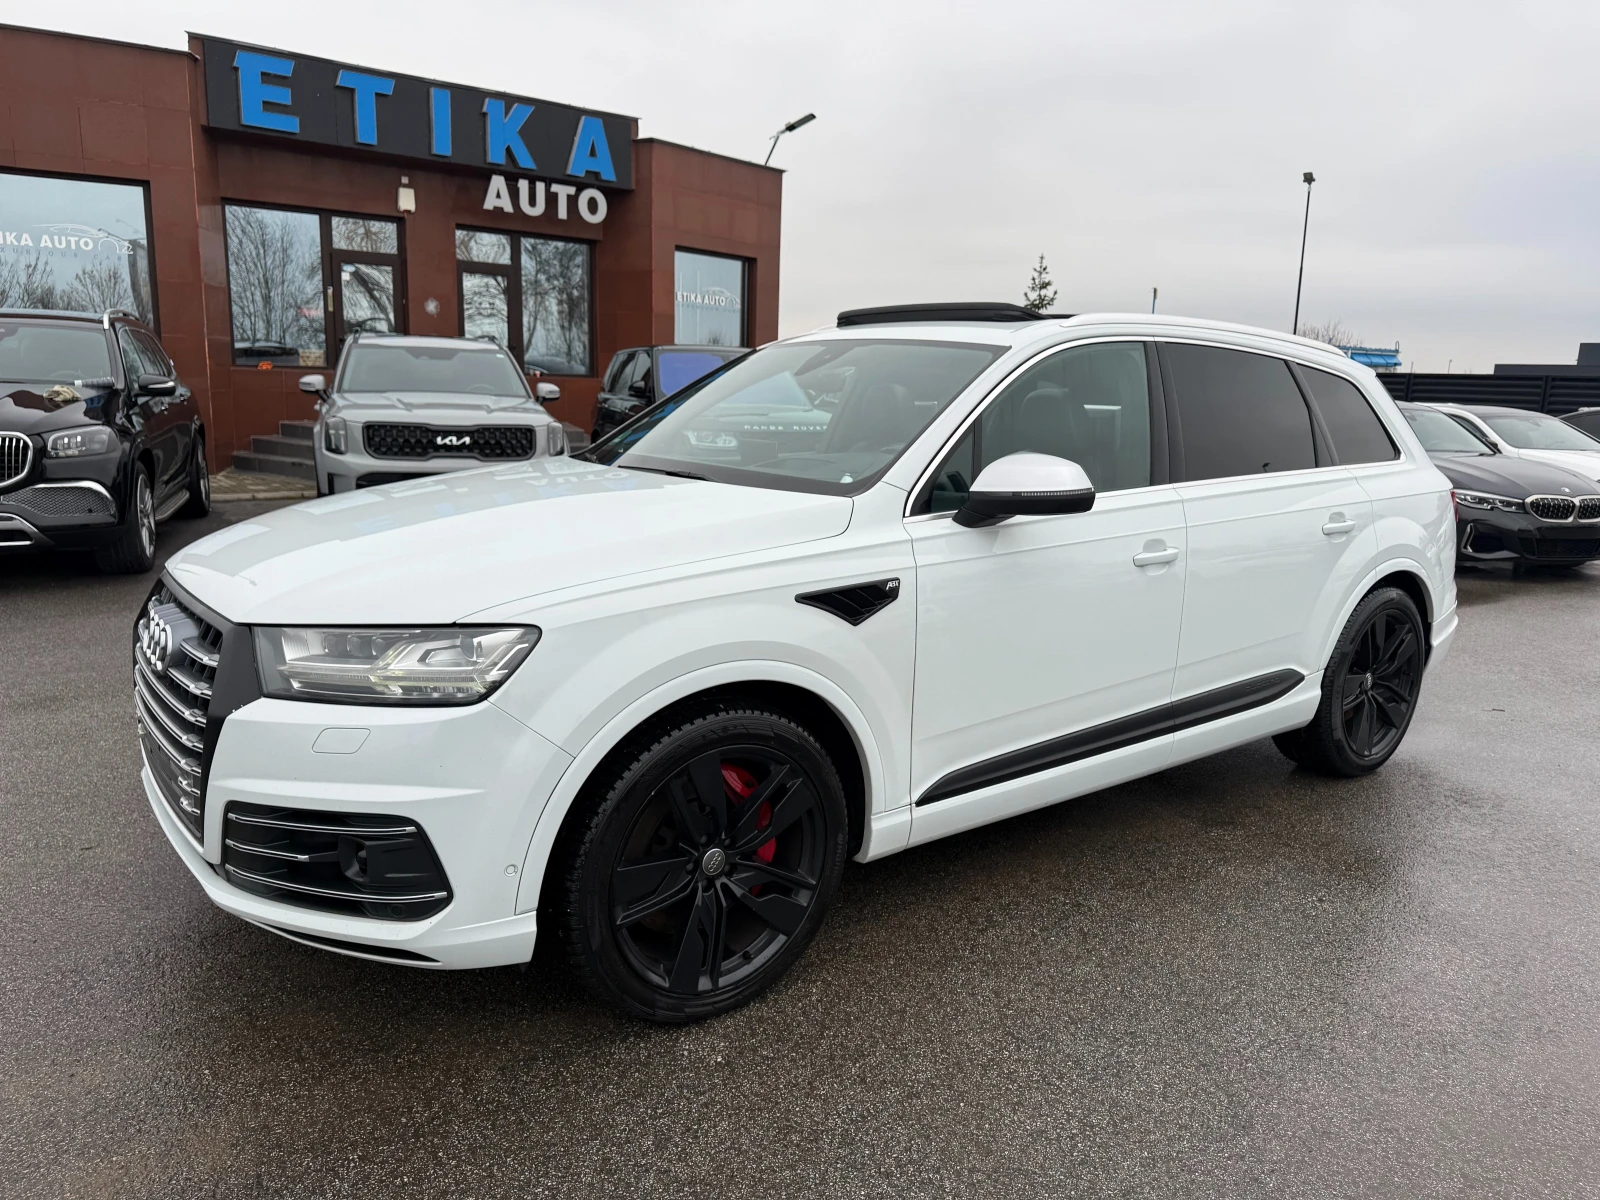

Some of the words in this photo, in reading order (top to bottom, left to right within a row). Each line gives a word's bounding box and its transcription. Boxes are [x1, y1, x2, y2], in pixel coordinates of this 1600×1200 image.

[233, 50, 617, 182] ETIKA
[482, 174, 608, 224] AUTO
[40, 234, 93, 250] AUTO
[676, 291, 702, 304] ETIKA
[703, 294, 726, 306] AUTO
[885, 579, 900, 591] ABT
